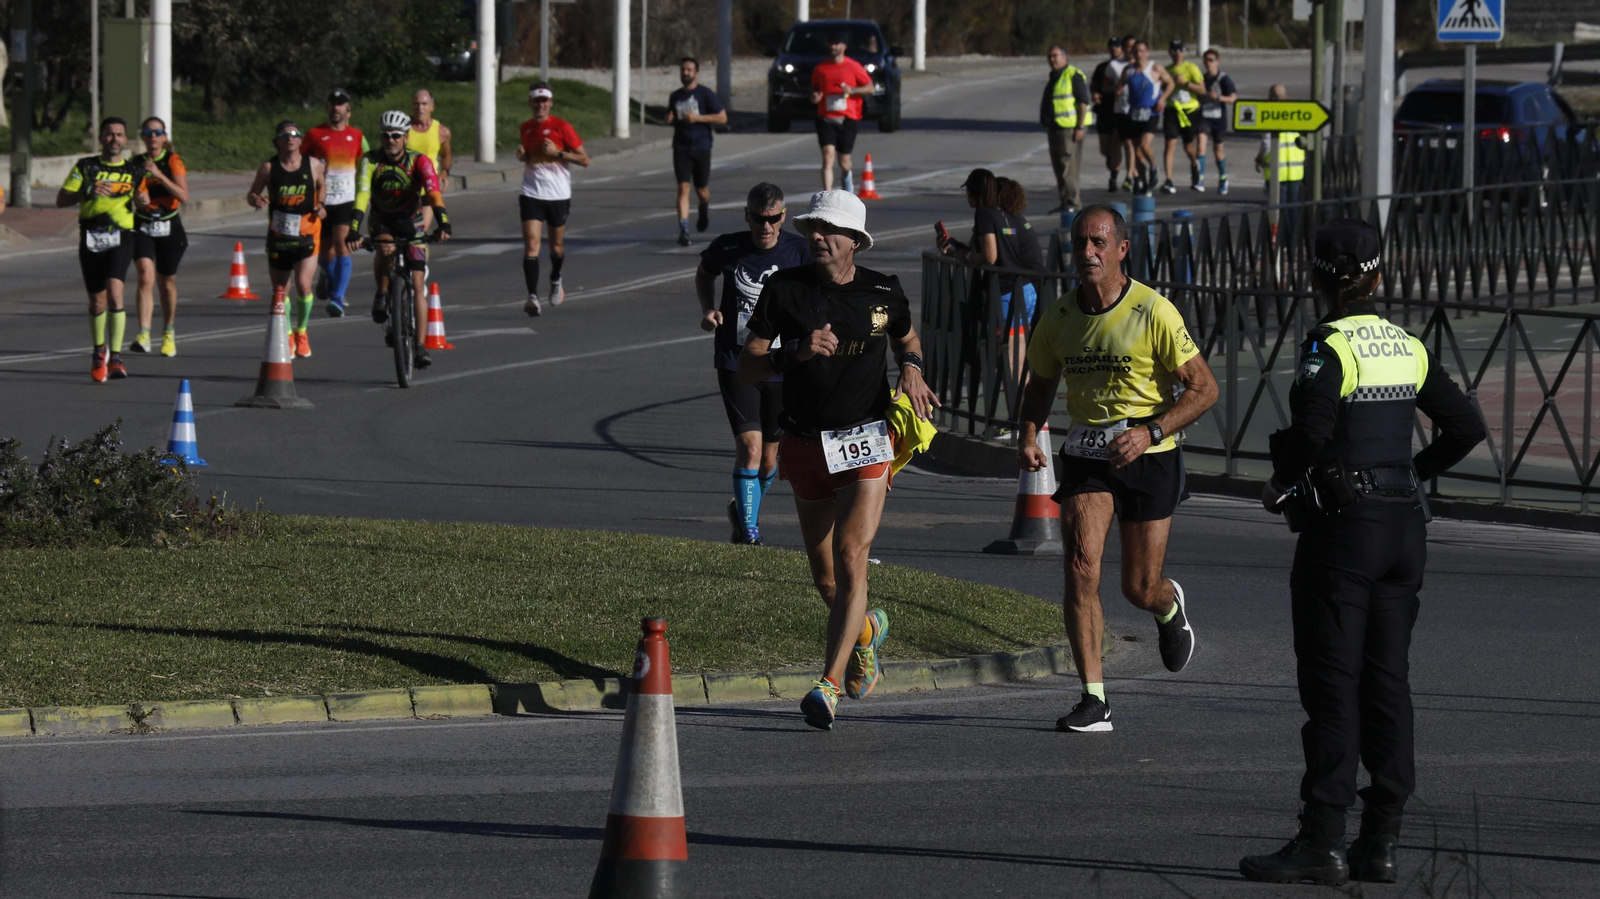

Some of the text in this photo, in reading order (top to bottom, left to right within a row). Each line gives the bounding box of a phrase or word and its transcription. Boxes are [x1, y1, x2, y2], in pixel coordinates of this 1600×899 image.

[1261, 109, 1312, 123] puerto
[1343, 325, 1410, 342] POLICIA
[1358, 342, 1413, 358] LOCAL
[1064, 355, 1132, 365] TESORILLO
[1080, 429, 1107, 448] 183
[838, 440, 871, 461] 195
[743, 480, 754, 523] kalenji
